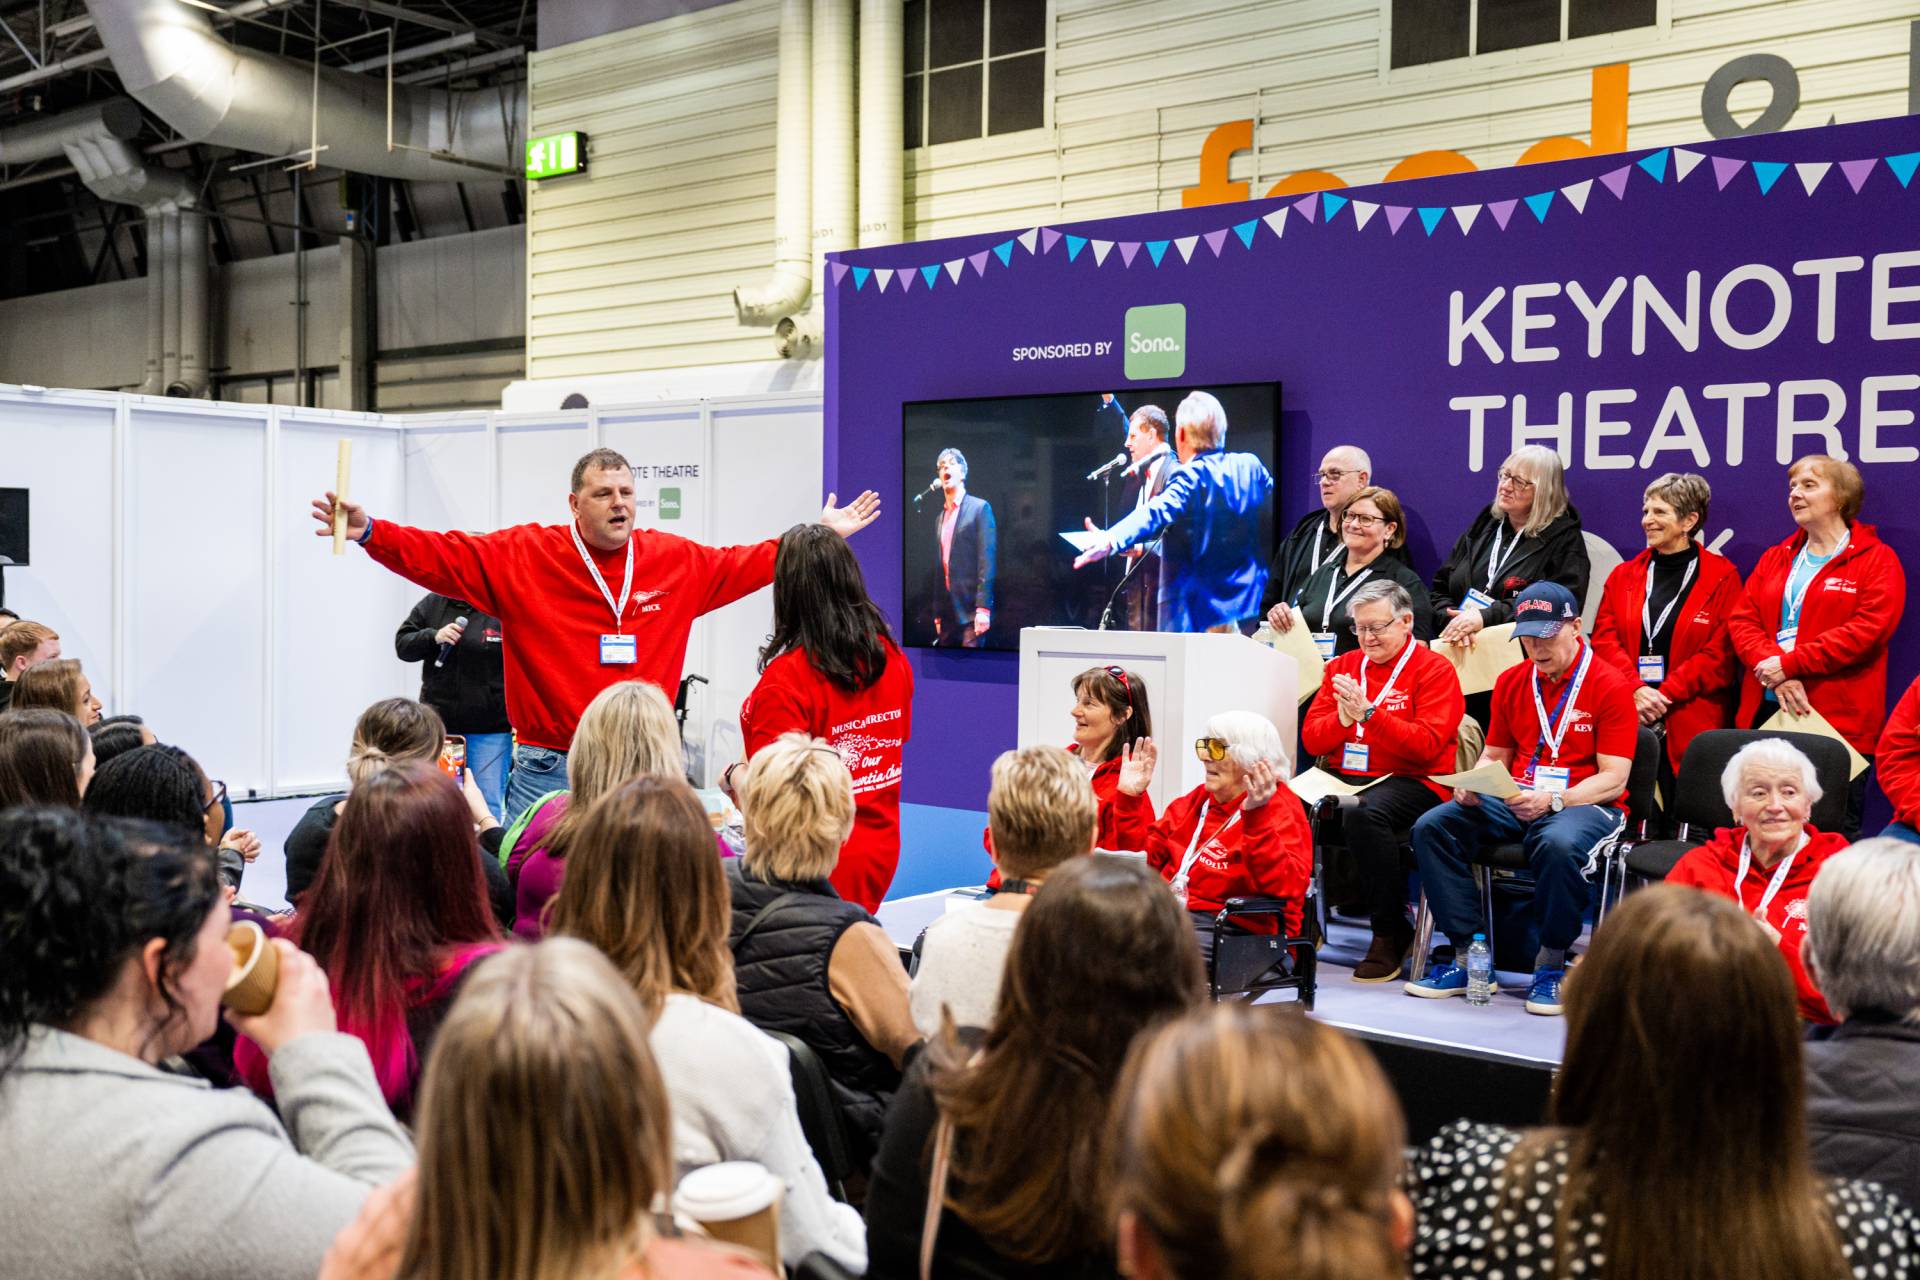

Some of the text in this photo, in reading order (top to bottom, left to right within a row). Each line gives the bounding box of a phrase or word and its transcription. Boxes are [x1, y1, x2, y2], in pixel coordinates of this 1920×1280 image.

[1449, 250, 1920, 367] KEYNOTE
[1129, 332, 1181, 354] Sona.
[1012, 341, 1113, 362] SPONSORED BY
[1449, 374, 1920, 472] THEATRE
[652, 464, 699, 478] THEATRE
[641, 603, 661, 613] MICK
[1386, 701, 1407, 712] MEL
[831, 719, 866, 735] MUSICA
[861, 755, 883, 769] Our
